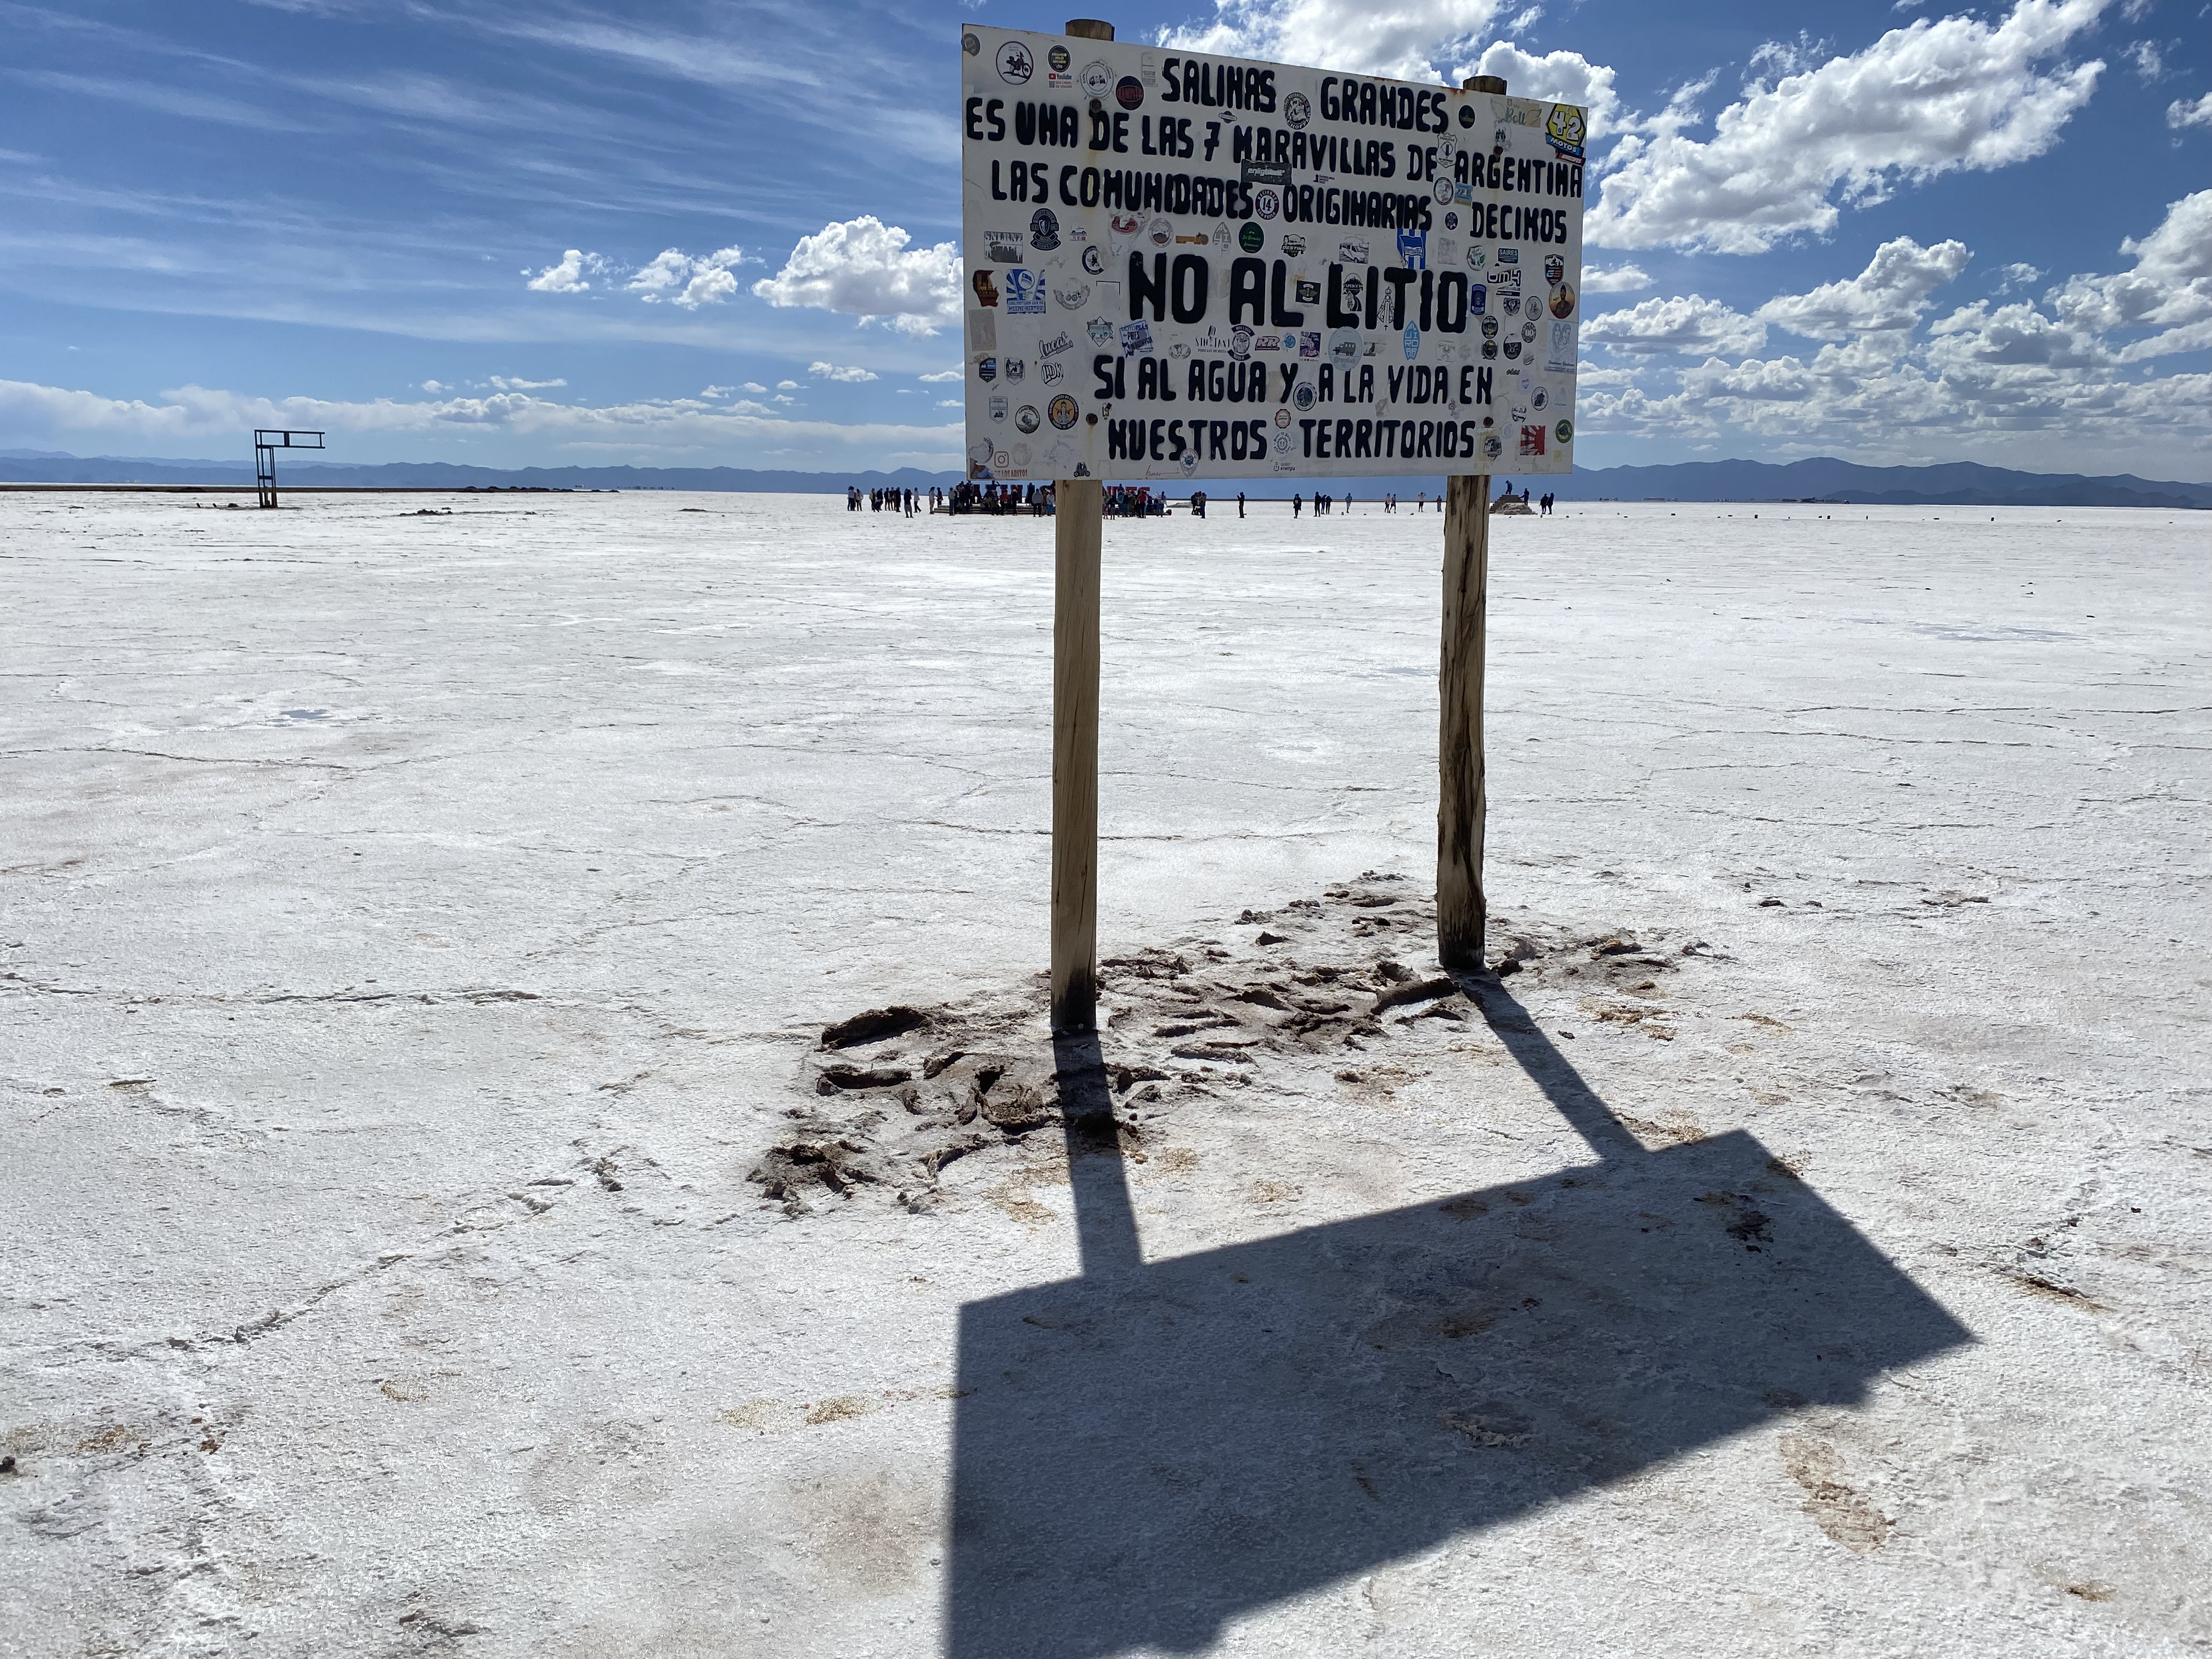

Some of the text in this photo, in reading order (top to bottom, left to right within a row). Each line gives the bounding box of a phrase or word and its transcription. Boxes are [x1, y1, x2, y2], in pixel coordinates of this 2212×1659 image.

[1161, 58, 1276, 112] SALINAS
[1321, 77, 1449, 134] GRANDES
[966, 97, 1583, 198] ES UNA DE LAS 7 MARAVILLAS DE ARGENTINA
[1550, 137, 1578, 153] MOTOS
[1551, 110, 1582, 143] 42
[991, 159, 1048, 204] LAS
[1283, 184, 1432, 232] ORIGINARIAS
[1470, 201, 1567, 244] DECIMOS
[1263, 199, 1272, 212] 14
[1128, 251, 1469, 334] NO AL LITIO
[1094, 355, 1492, 405] SI AL AGUA Y A LA VIDA EN
[1108, 419, 1476, 461] NUESTROS TERRITORIOS
